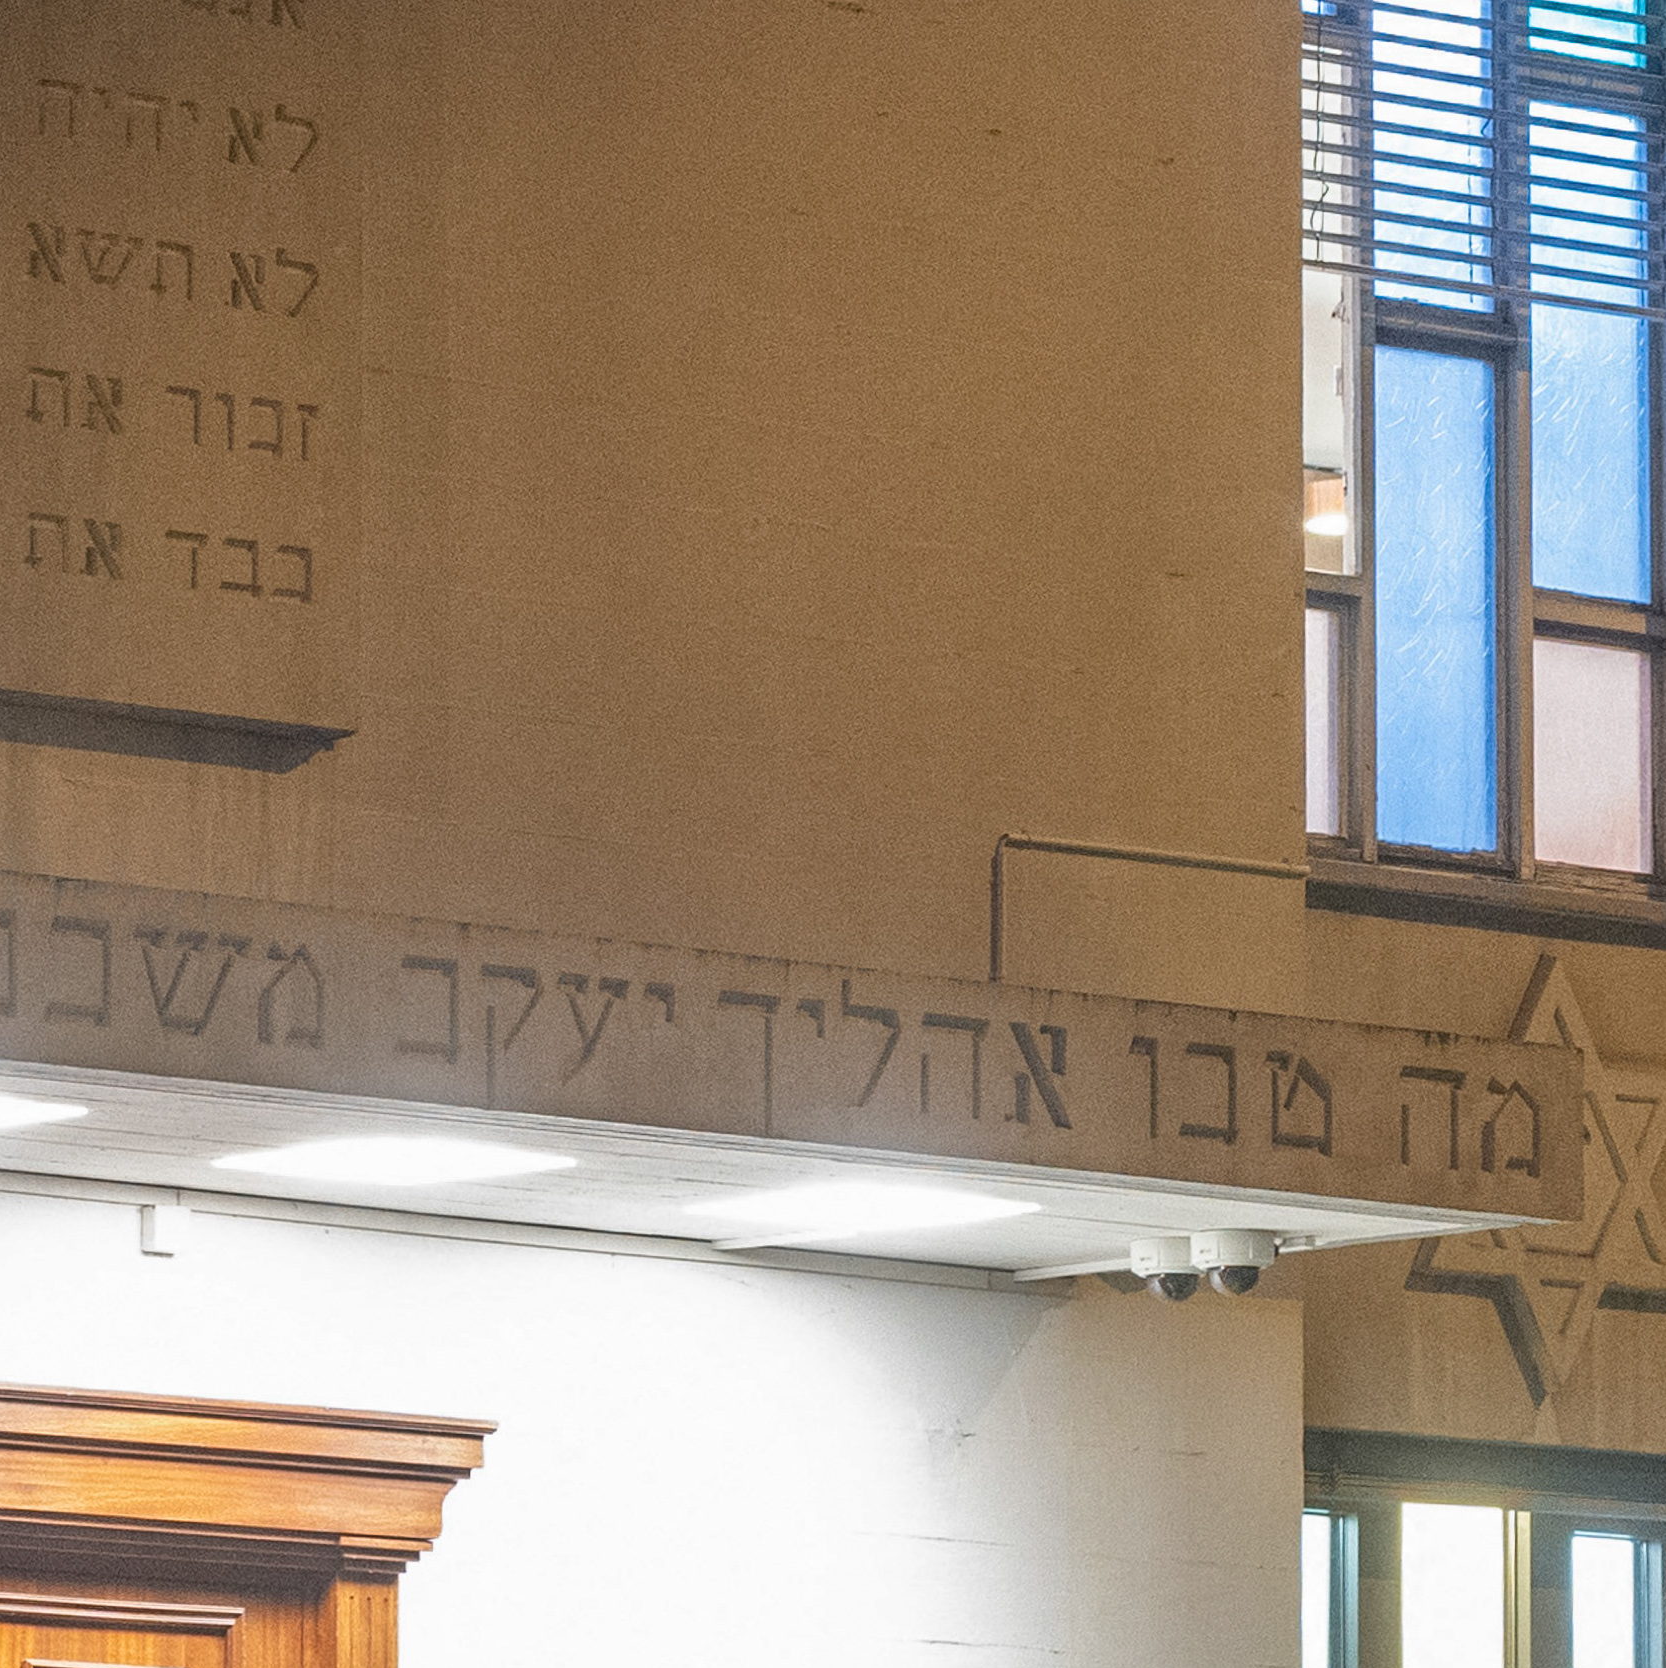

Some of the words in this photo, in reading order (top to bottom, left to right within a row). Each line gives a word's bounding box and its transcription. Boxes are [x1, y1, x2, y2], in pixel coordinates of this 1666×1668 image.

[37, 76, 201, 152] יהיה
[225, 102, 320, 173] לא
[27, 220, 195, 302] תשא
[229, 247, 320, 318] לא
[25, 364, 125, 436] את
[23, 510, 123, 582] את
[164, 527, 315, 605] כבד
[394, 954, 677, 1110] יעקב
[716, 978, 1072, 1134] אהליך
[1127, 1034, 1332, 1157] טבו
[1399, 1065, 1541, 1178] מה
